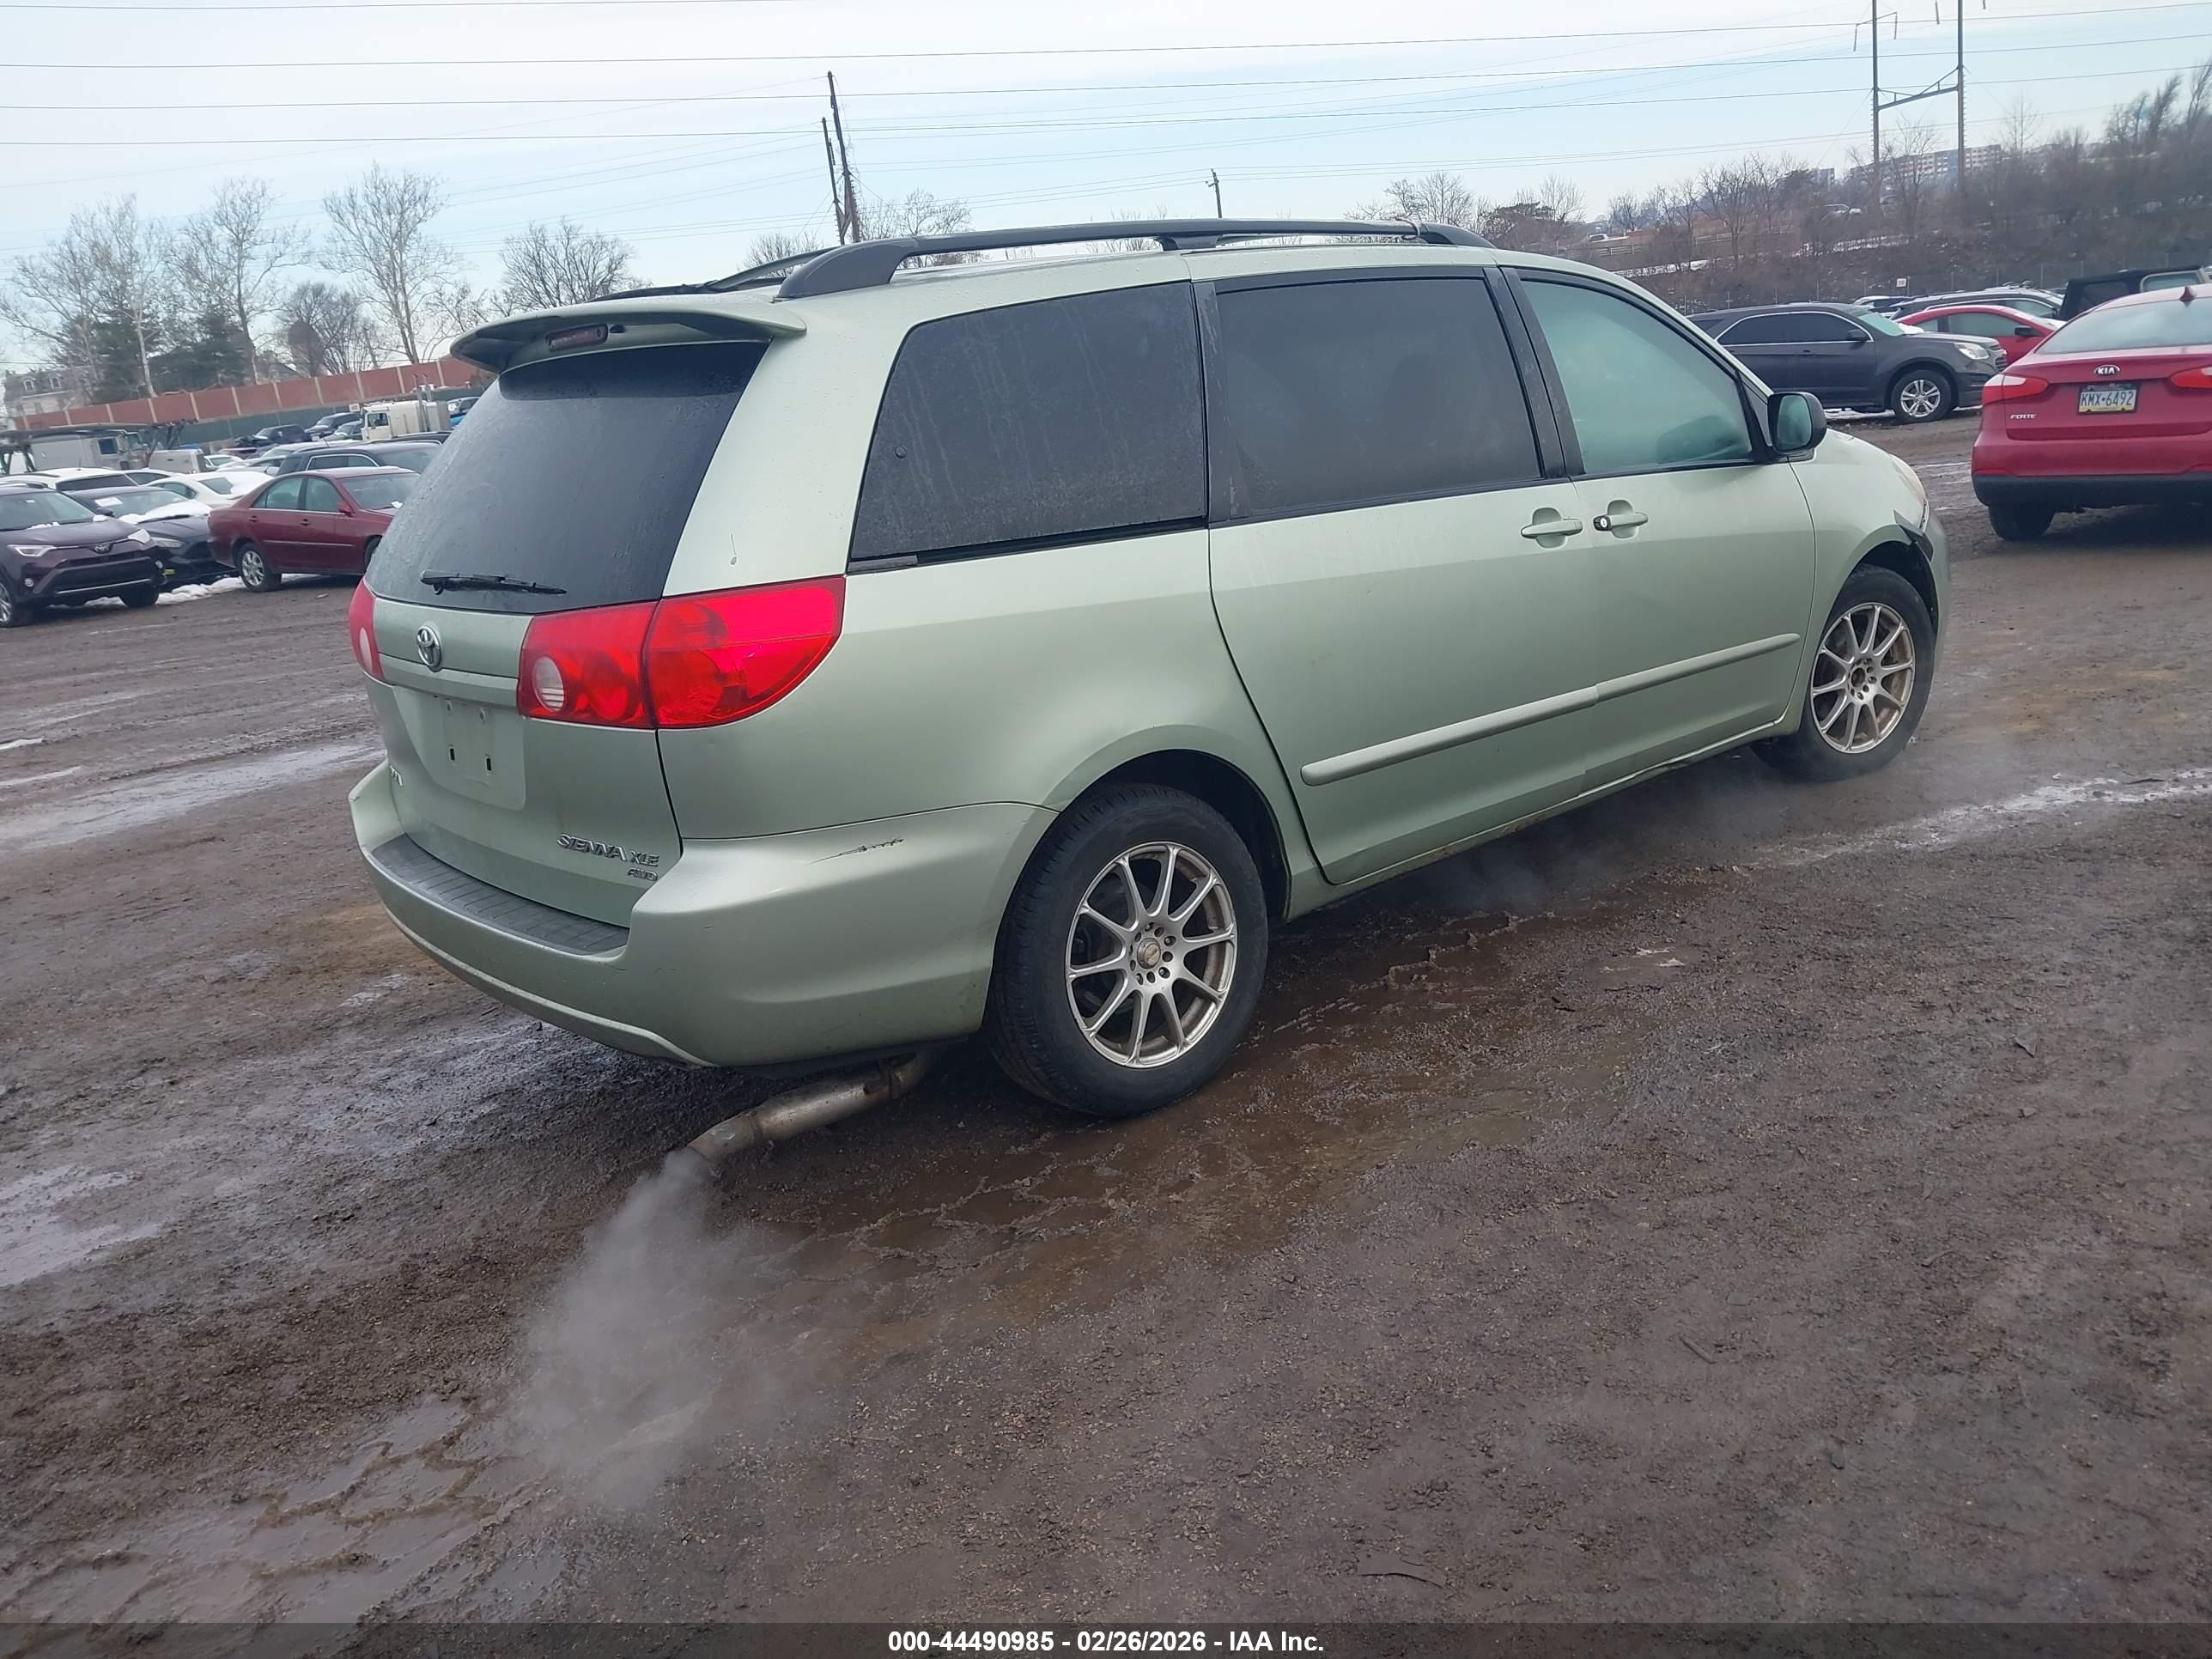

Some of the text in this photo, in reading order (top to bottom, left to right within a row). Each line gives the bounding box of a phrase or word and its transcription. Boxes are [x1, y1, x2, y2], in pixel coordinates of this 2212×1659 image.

[2097, 366, 2117, 375] KIA
[556, 832, 659, 867] SIENNA XLE
